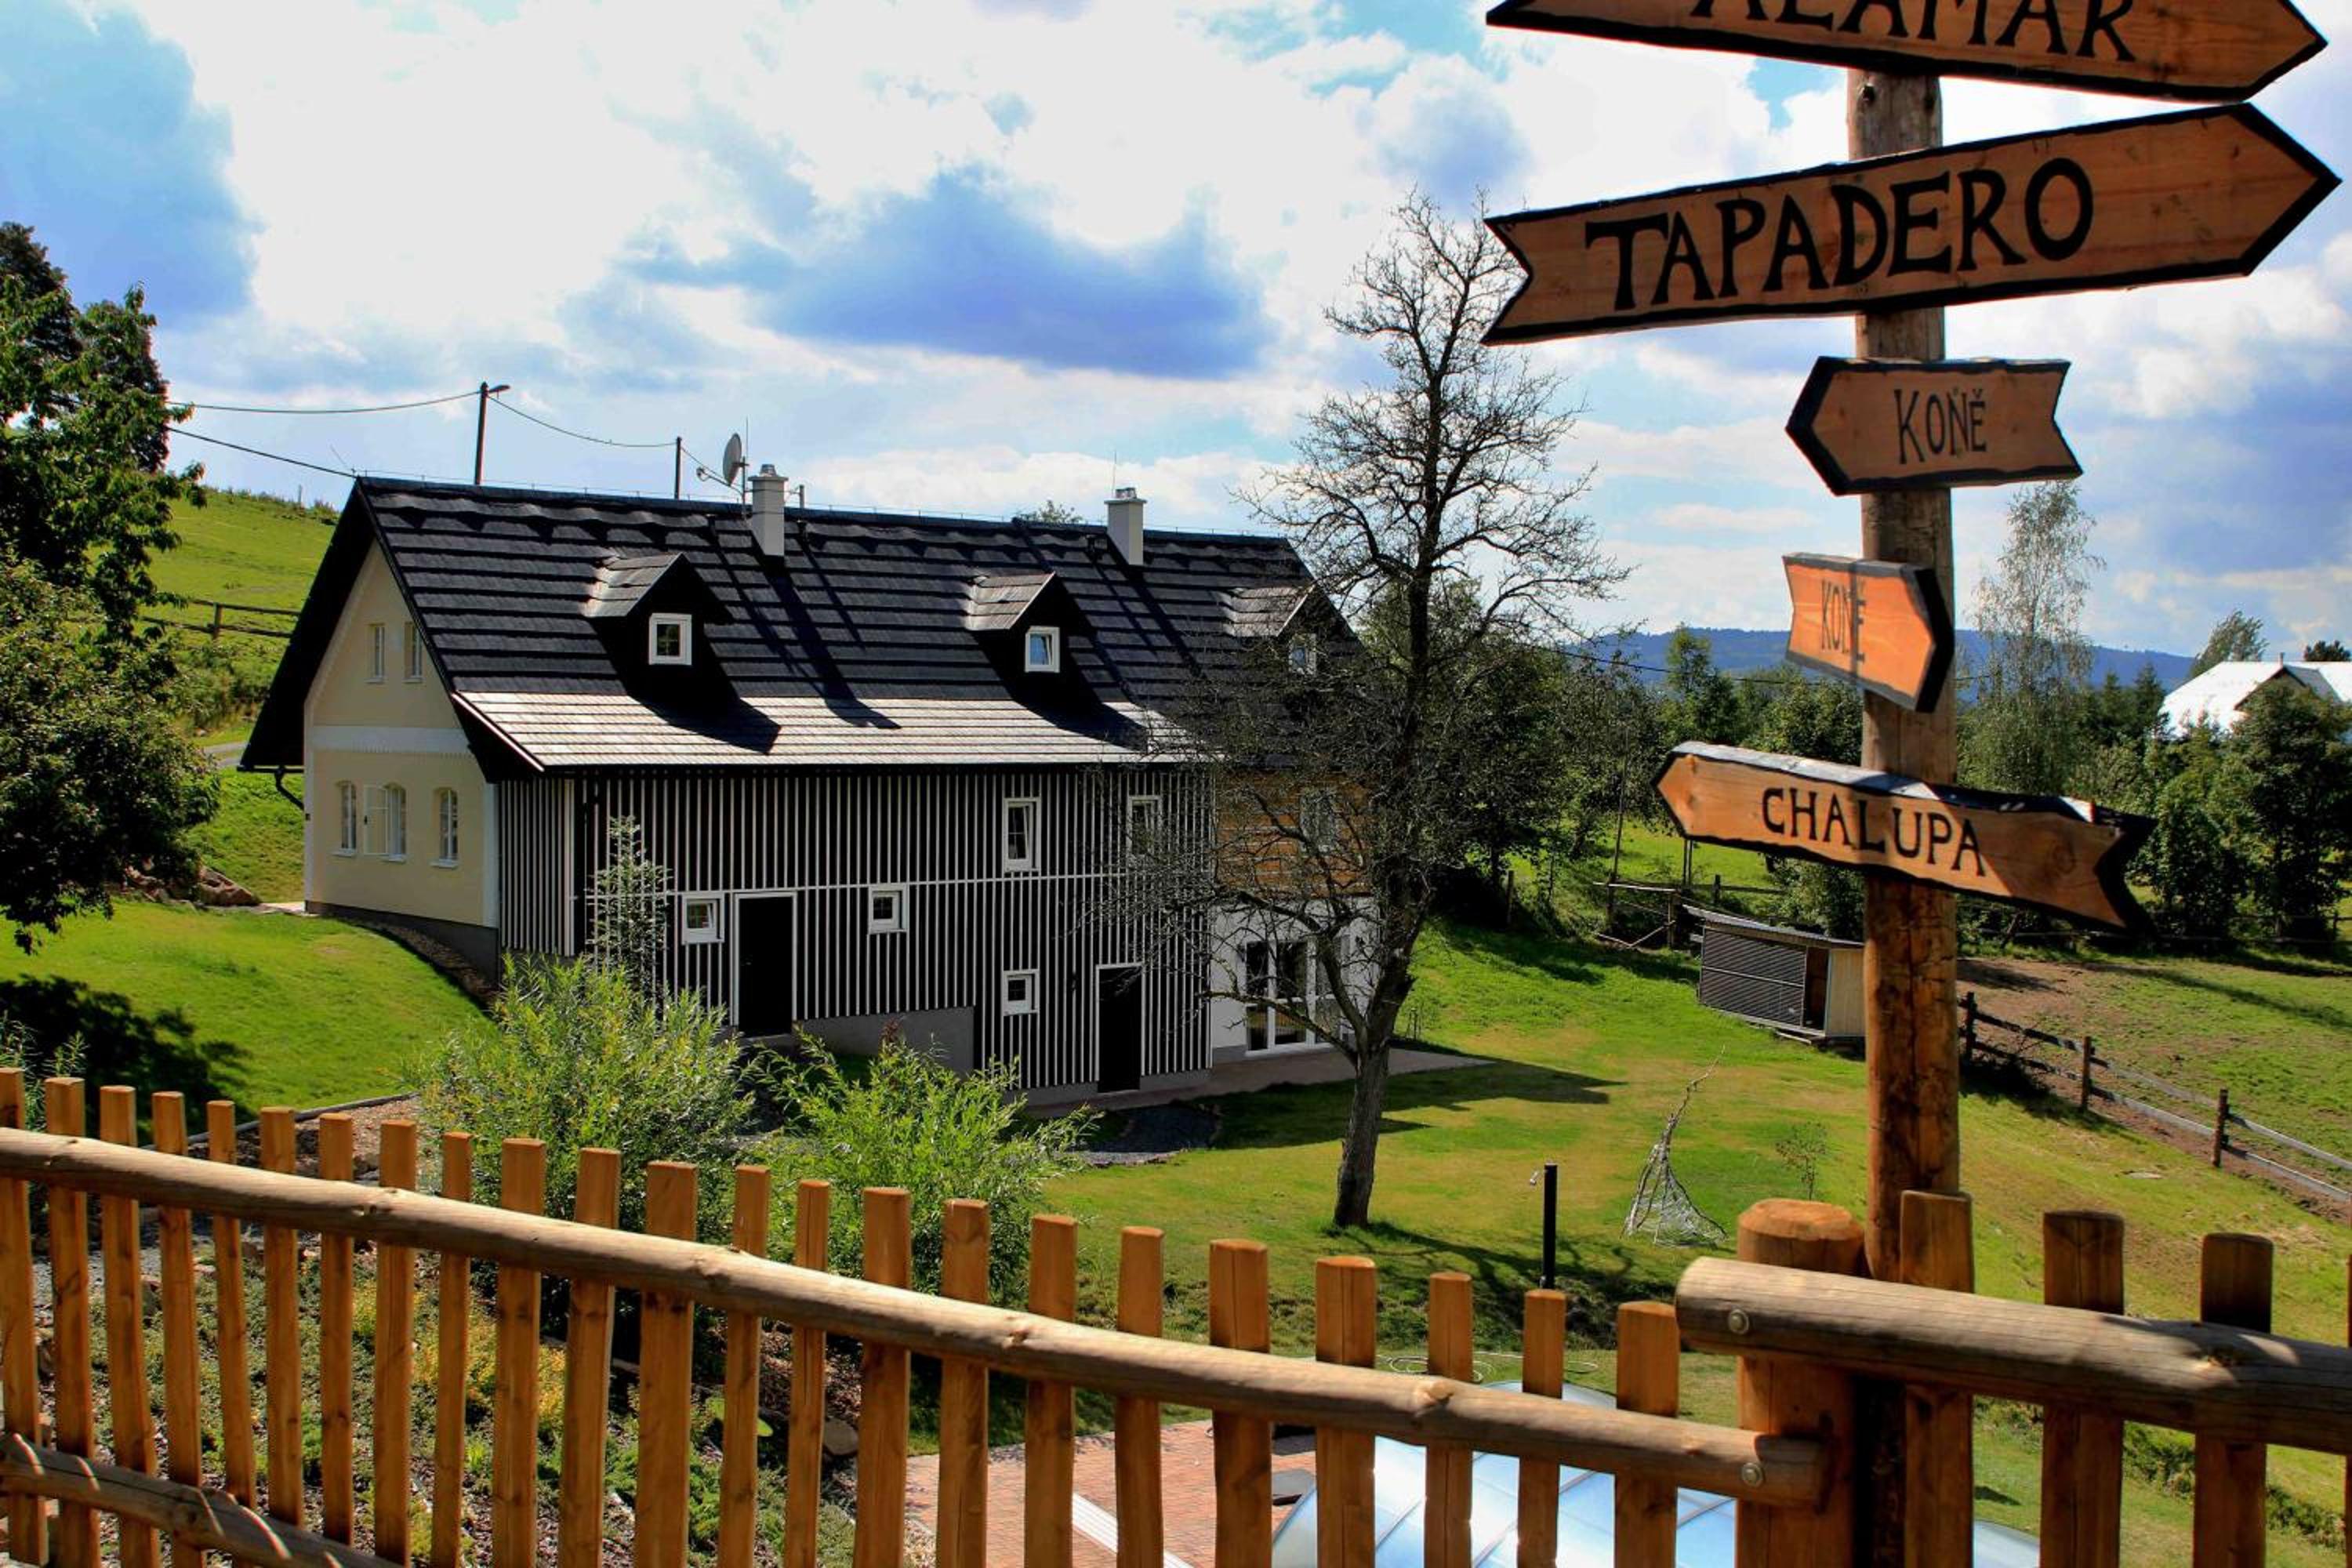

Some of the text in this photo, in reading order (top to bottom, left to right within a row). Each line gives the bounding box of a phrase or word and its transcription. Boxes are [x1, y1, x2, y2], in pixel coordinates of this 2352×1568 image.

[1690, 0, 2136, 62] MAR
[1585, 158, 2093, 310] TAPADERO
[1762, 787, 1987, 877] CHALUPA
